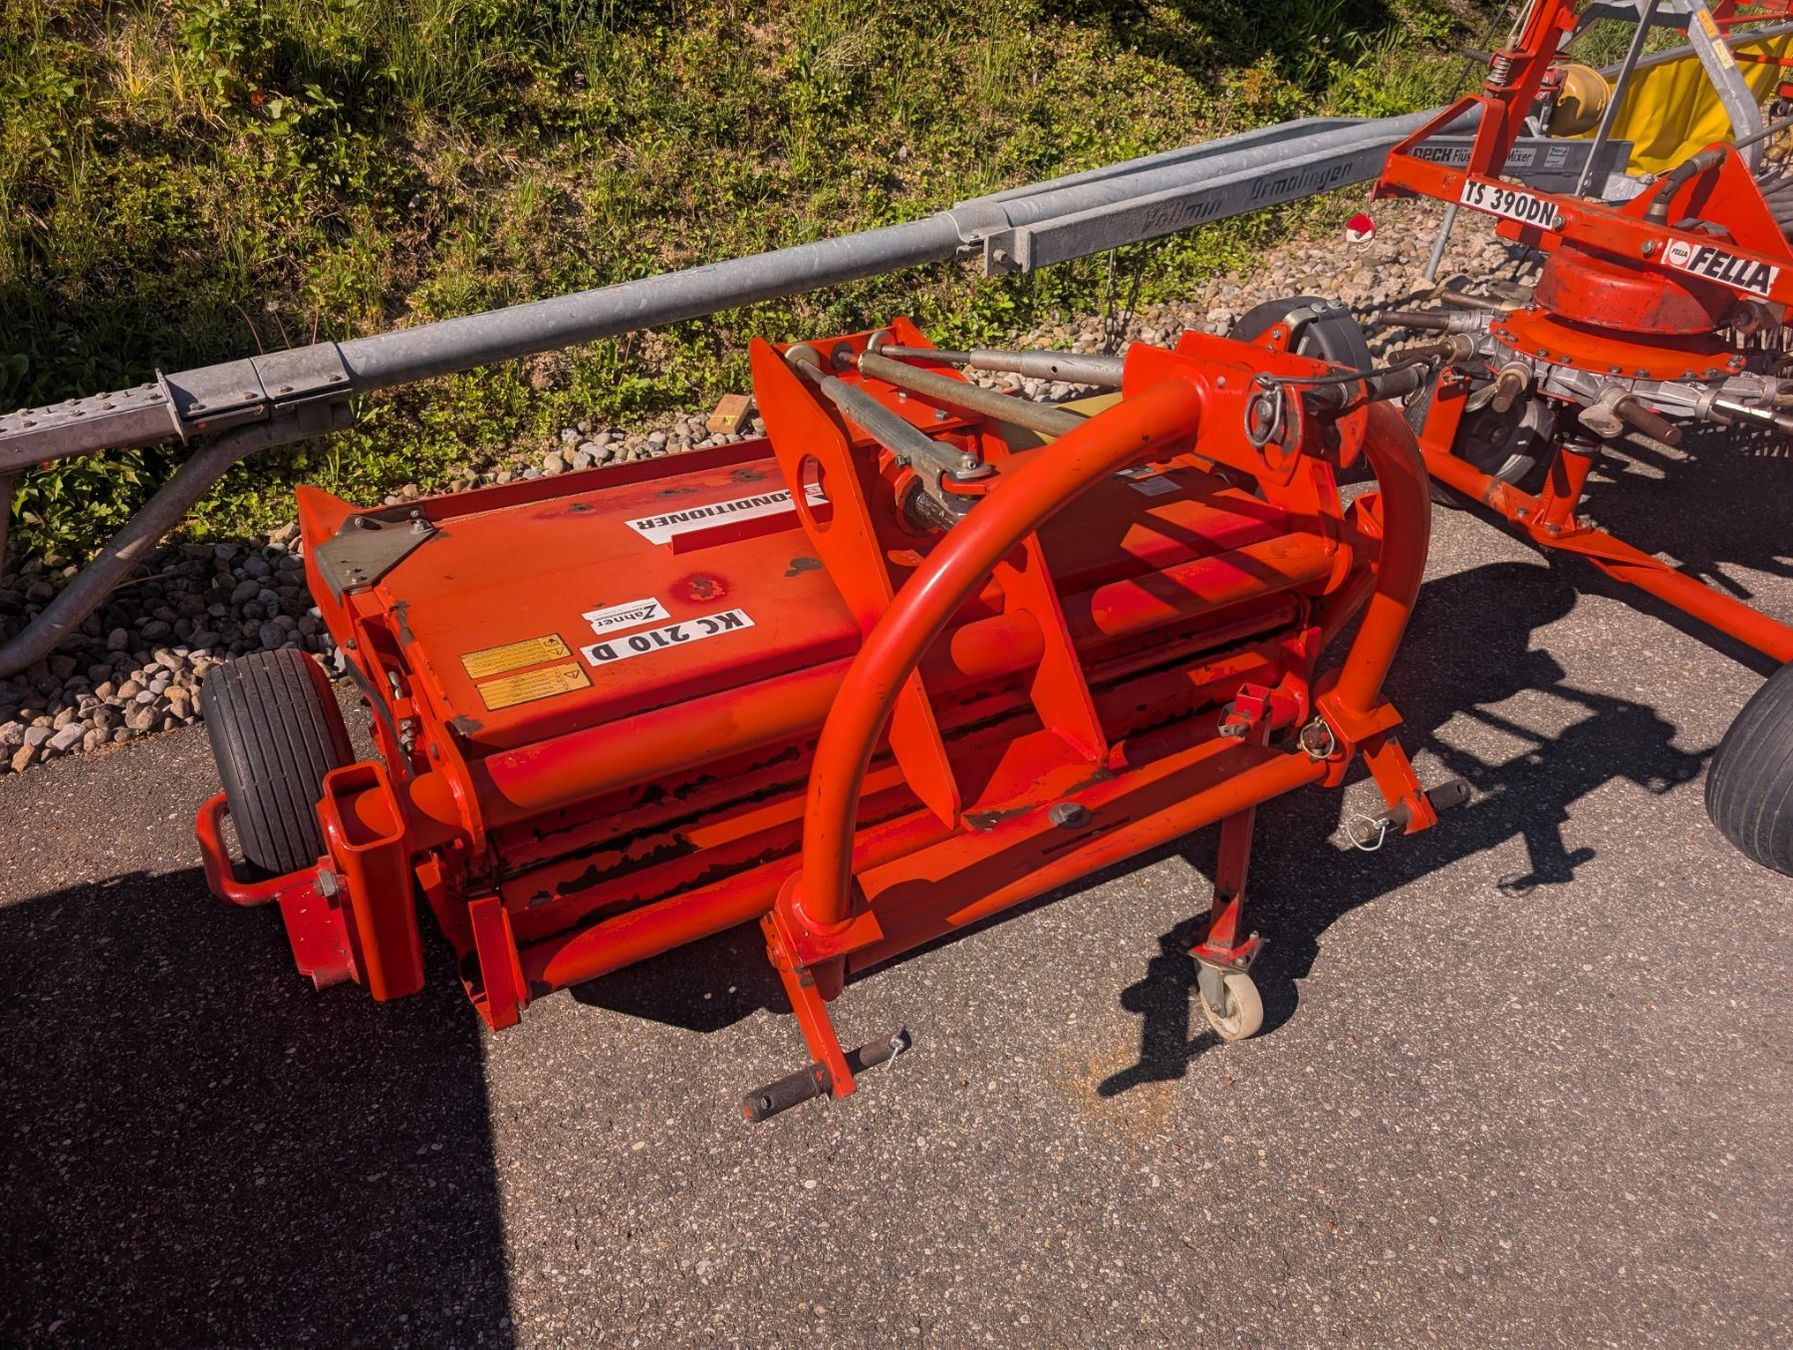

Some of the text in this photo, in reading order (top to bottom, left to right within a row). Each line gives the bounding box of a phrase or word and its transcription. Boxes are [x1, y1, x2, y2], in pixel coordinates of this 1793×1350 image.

[1465, 181, 1556, 226] TS 390DN
[1671, 248, 1688, 258] FELLA
[1687, 246, 1772, 293] FELLA
[591, 611, 744, 661] KC 210 D
[597, 604, 657, 627] Zahner
